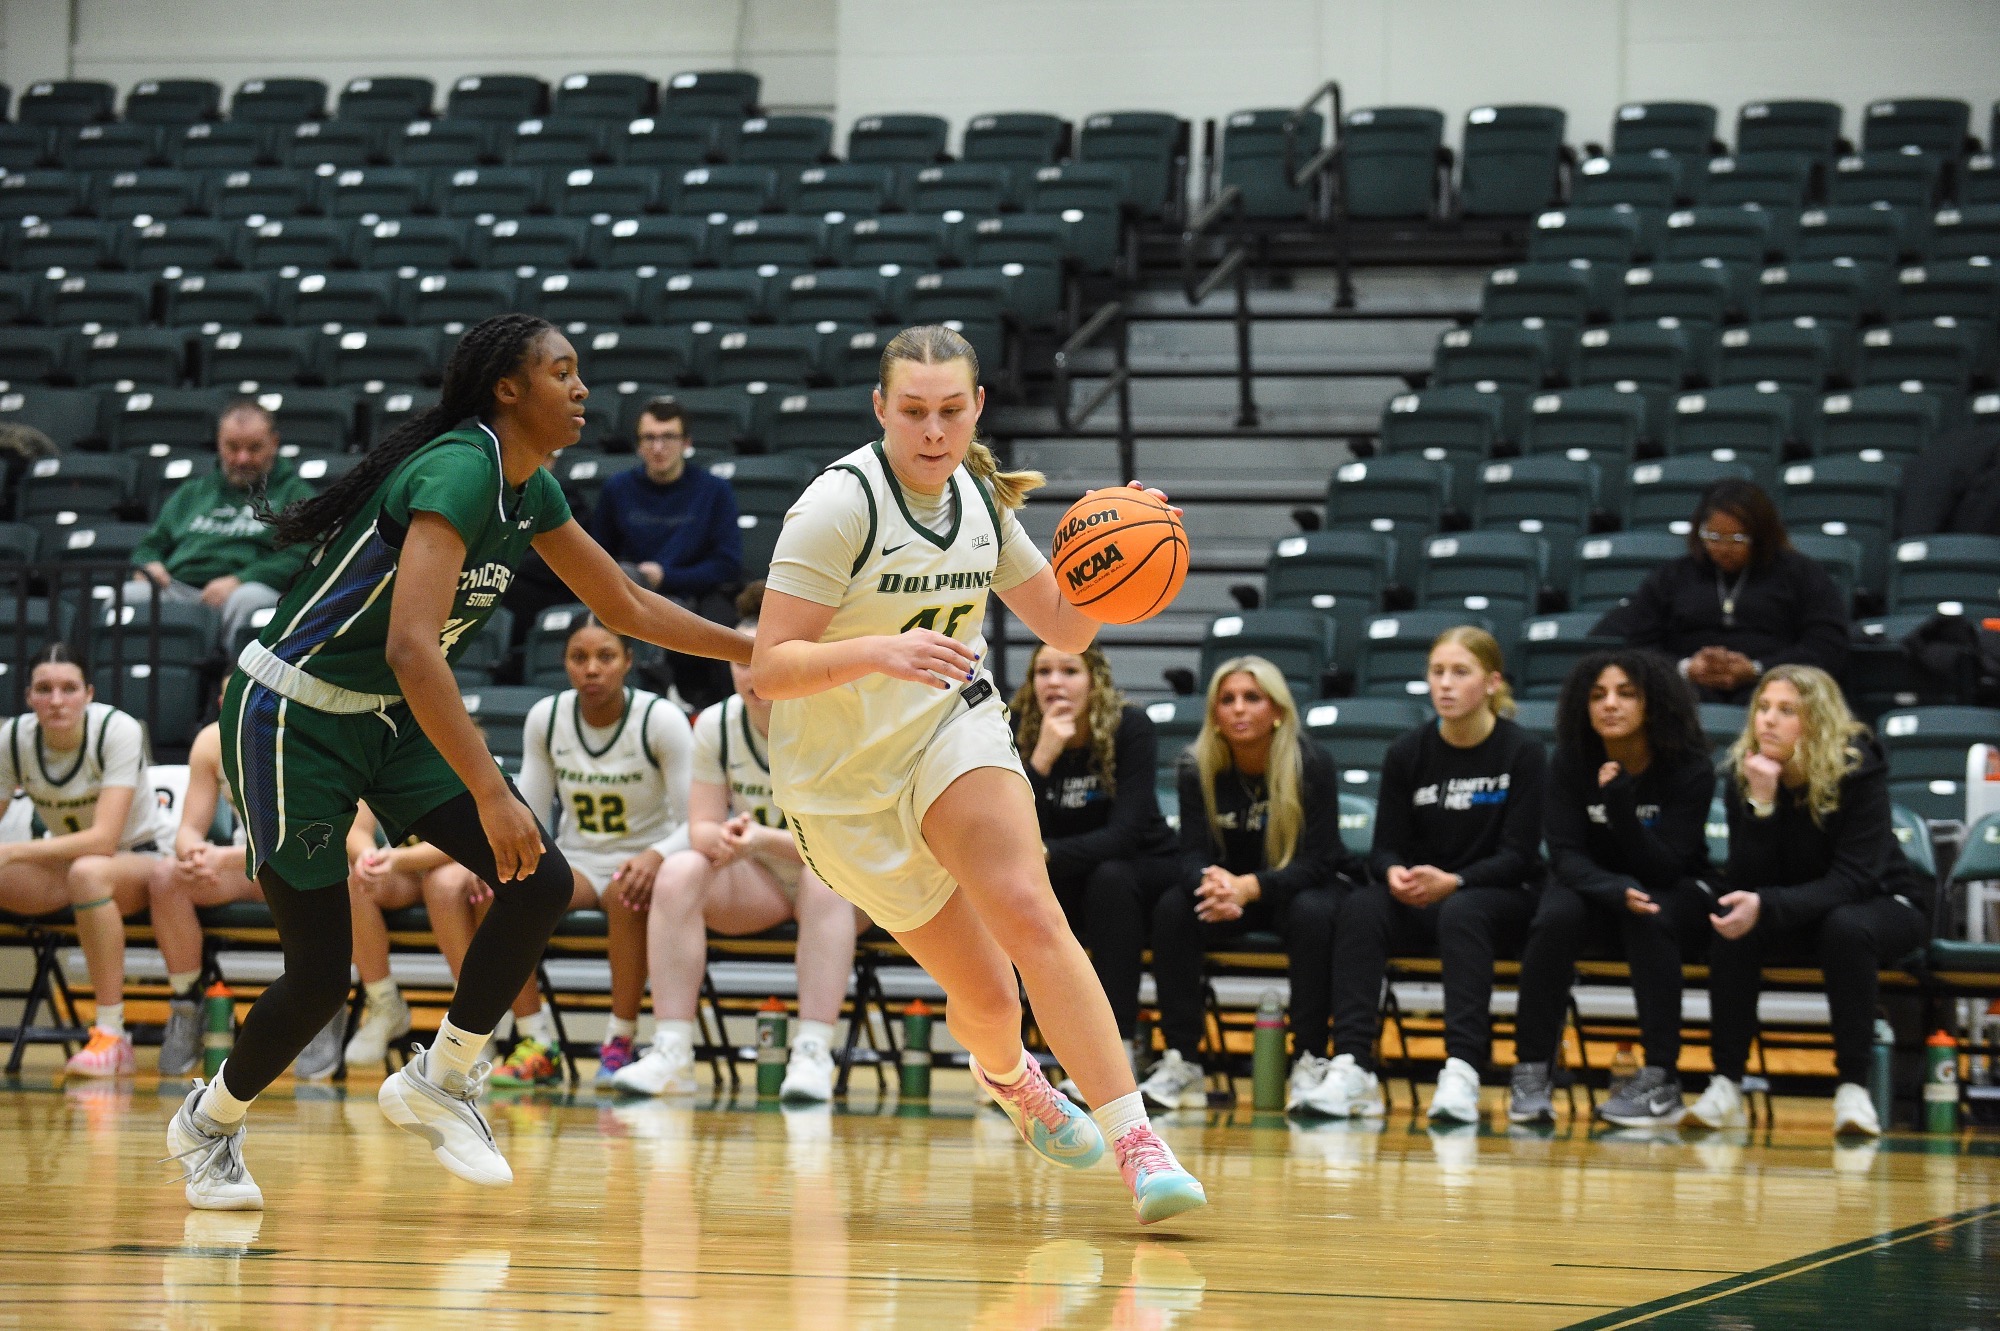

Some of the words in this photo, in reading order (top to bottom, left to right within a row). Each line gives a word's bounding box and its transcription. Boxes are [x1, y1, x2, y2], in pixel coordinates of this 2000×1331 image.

[1053, 508, 1120, 558] Wilson
[456, 562, 516, 593] HICAG
[876, 570, 994, 594] DOLPHINS
[1065, 543, 1125, 591] NCAA
[465, 592, 498, 607] STATE
[571, 791, 628, 835] 22
